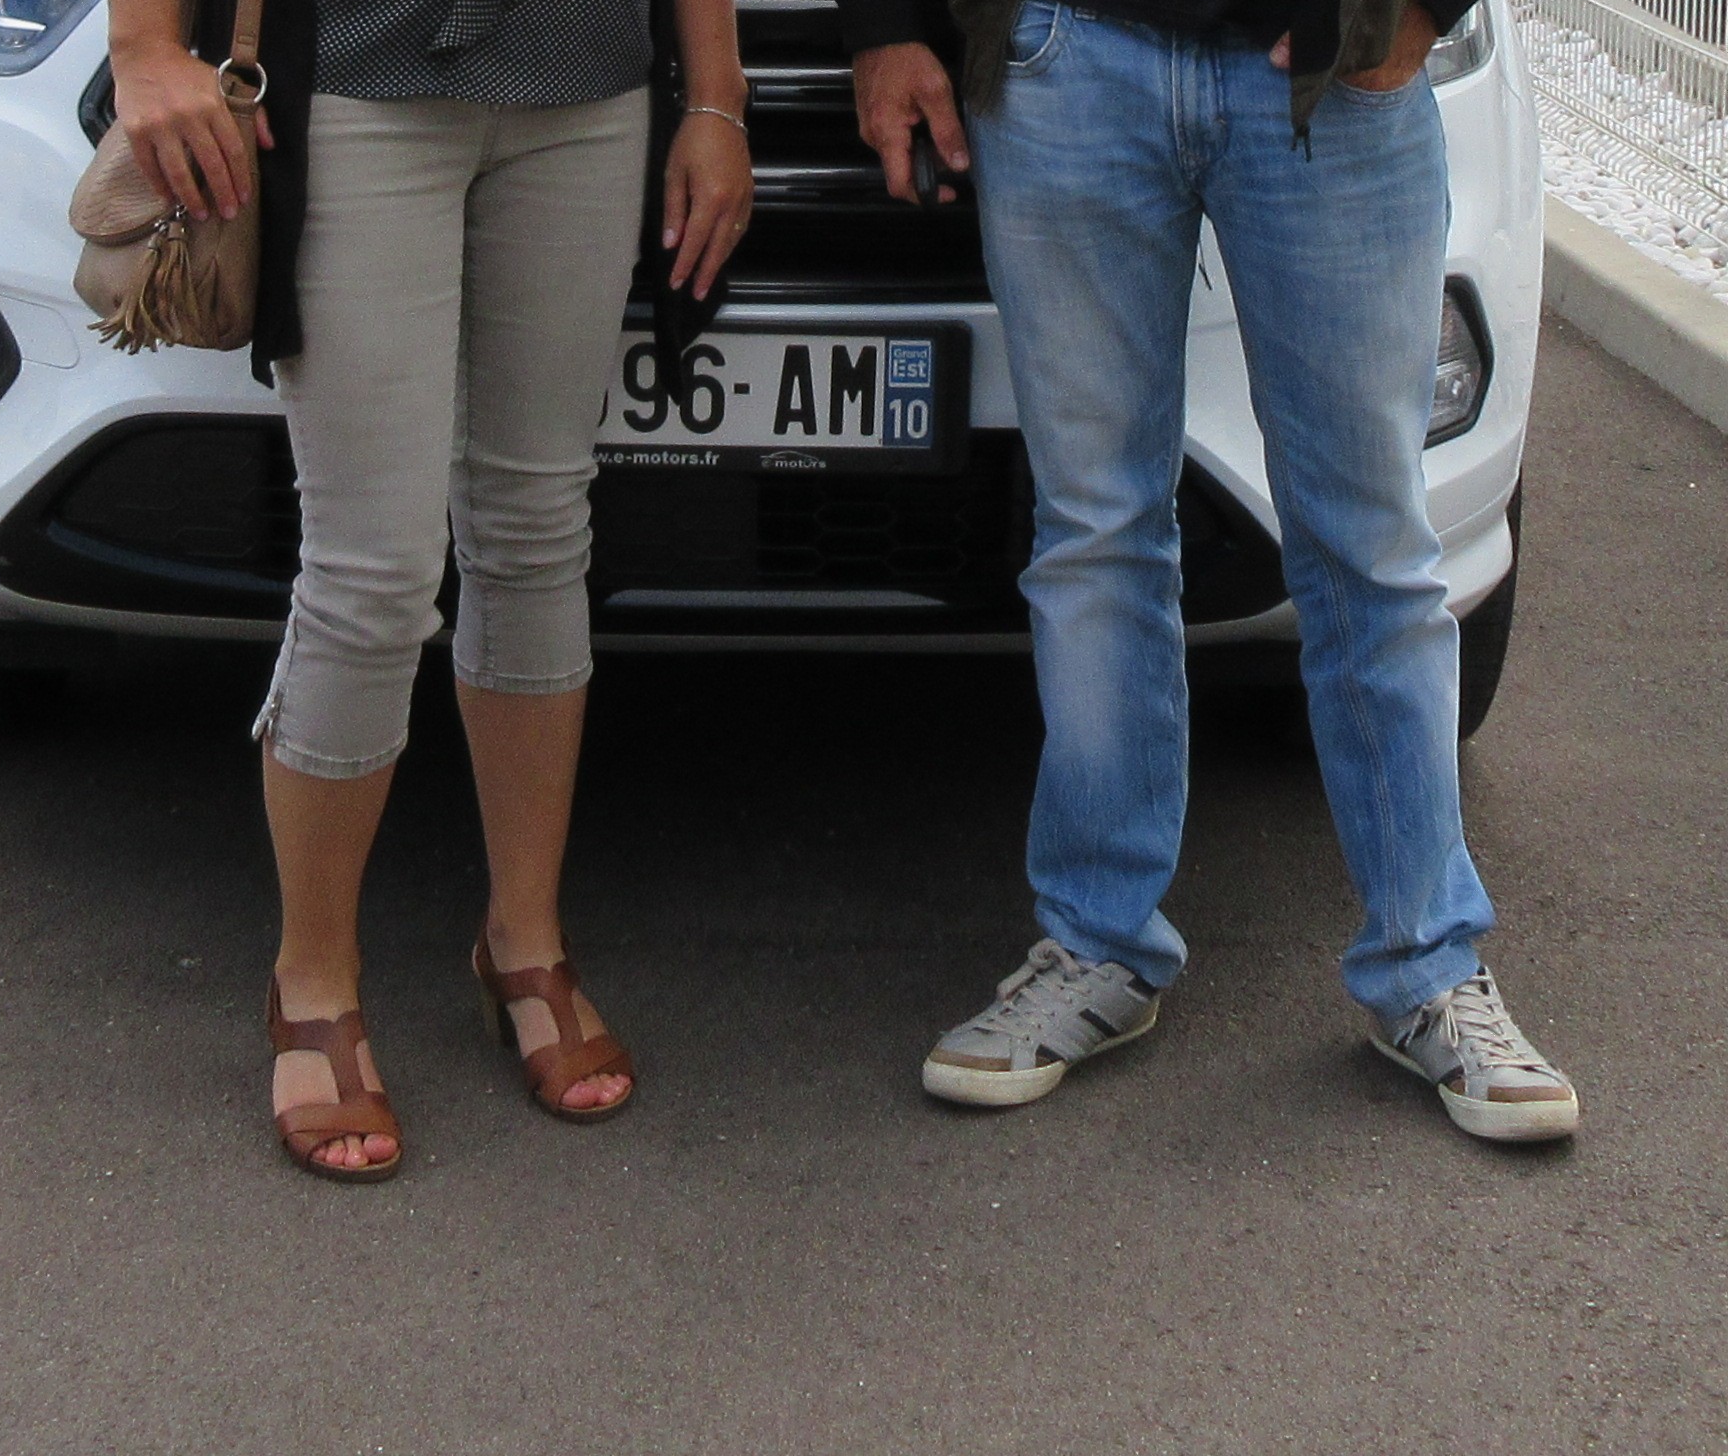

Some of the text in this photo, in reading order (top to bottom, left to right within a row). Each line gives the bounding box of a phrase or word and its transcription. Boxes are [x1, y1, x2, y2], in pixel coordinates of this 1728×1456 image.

[893, 348, 927, 359] Grand
[893, 359, 927, 378] Est
[773, 344, 877, 436] AM
[889, 398, 929, 439] 10
